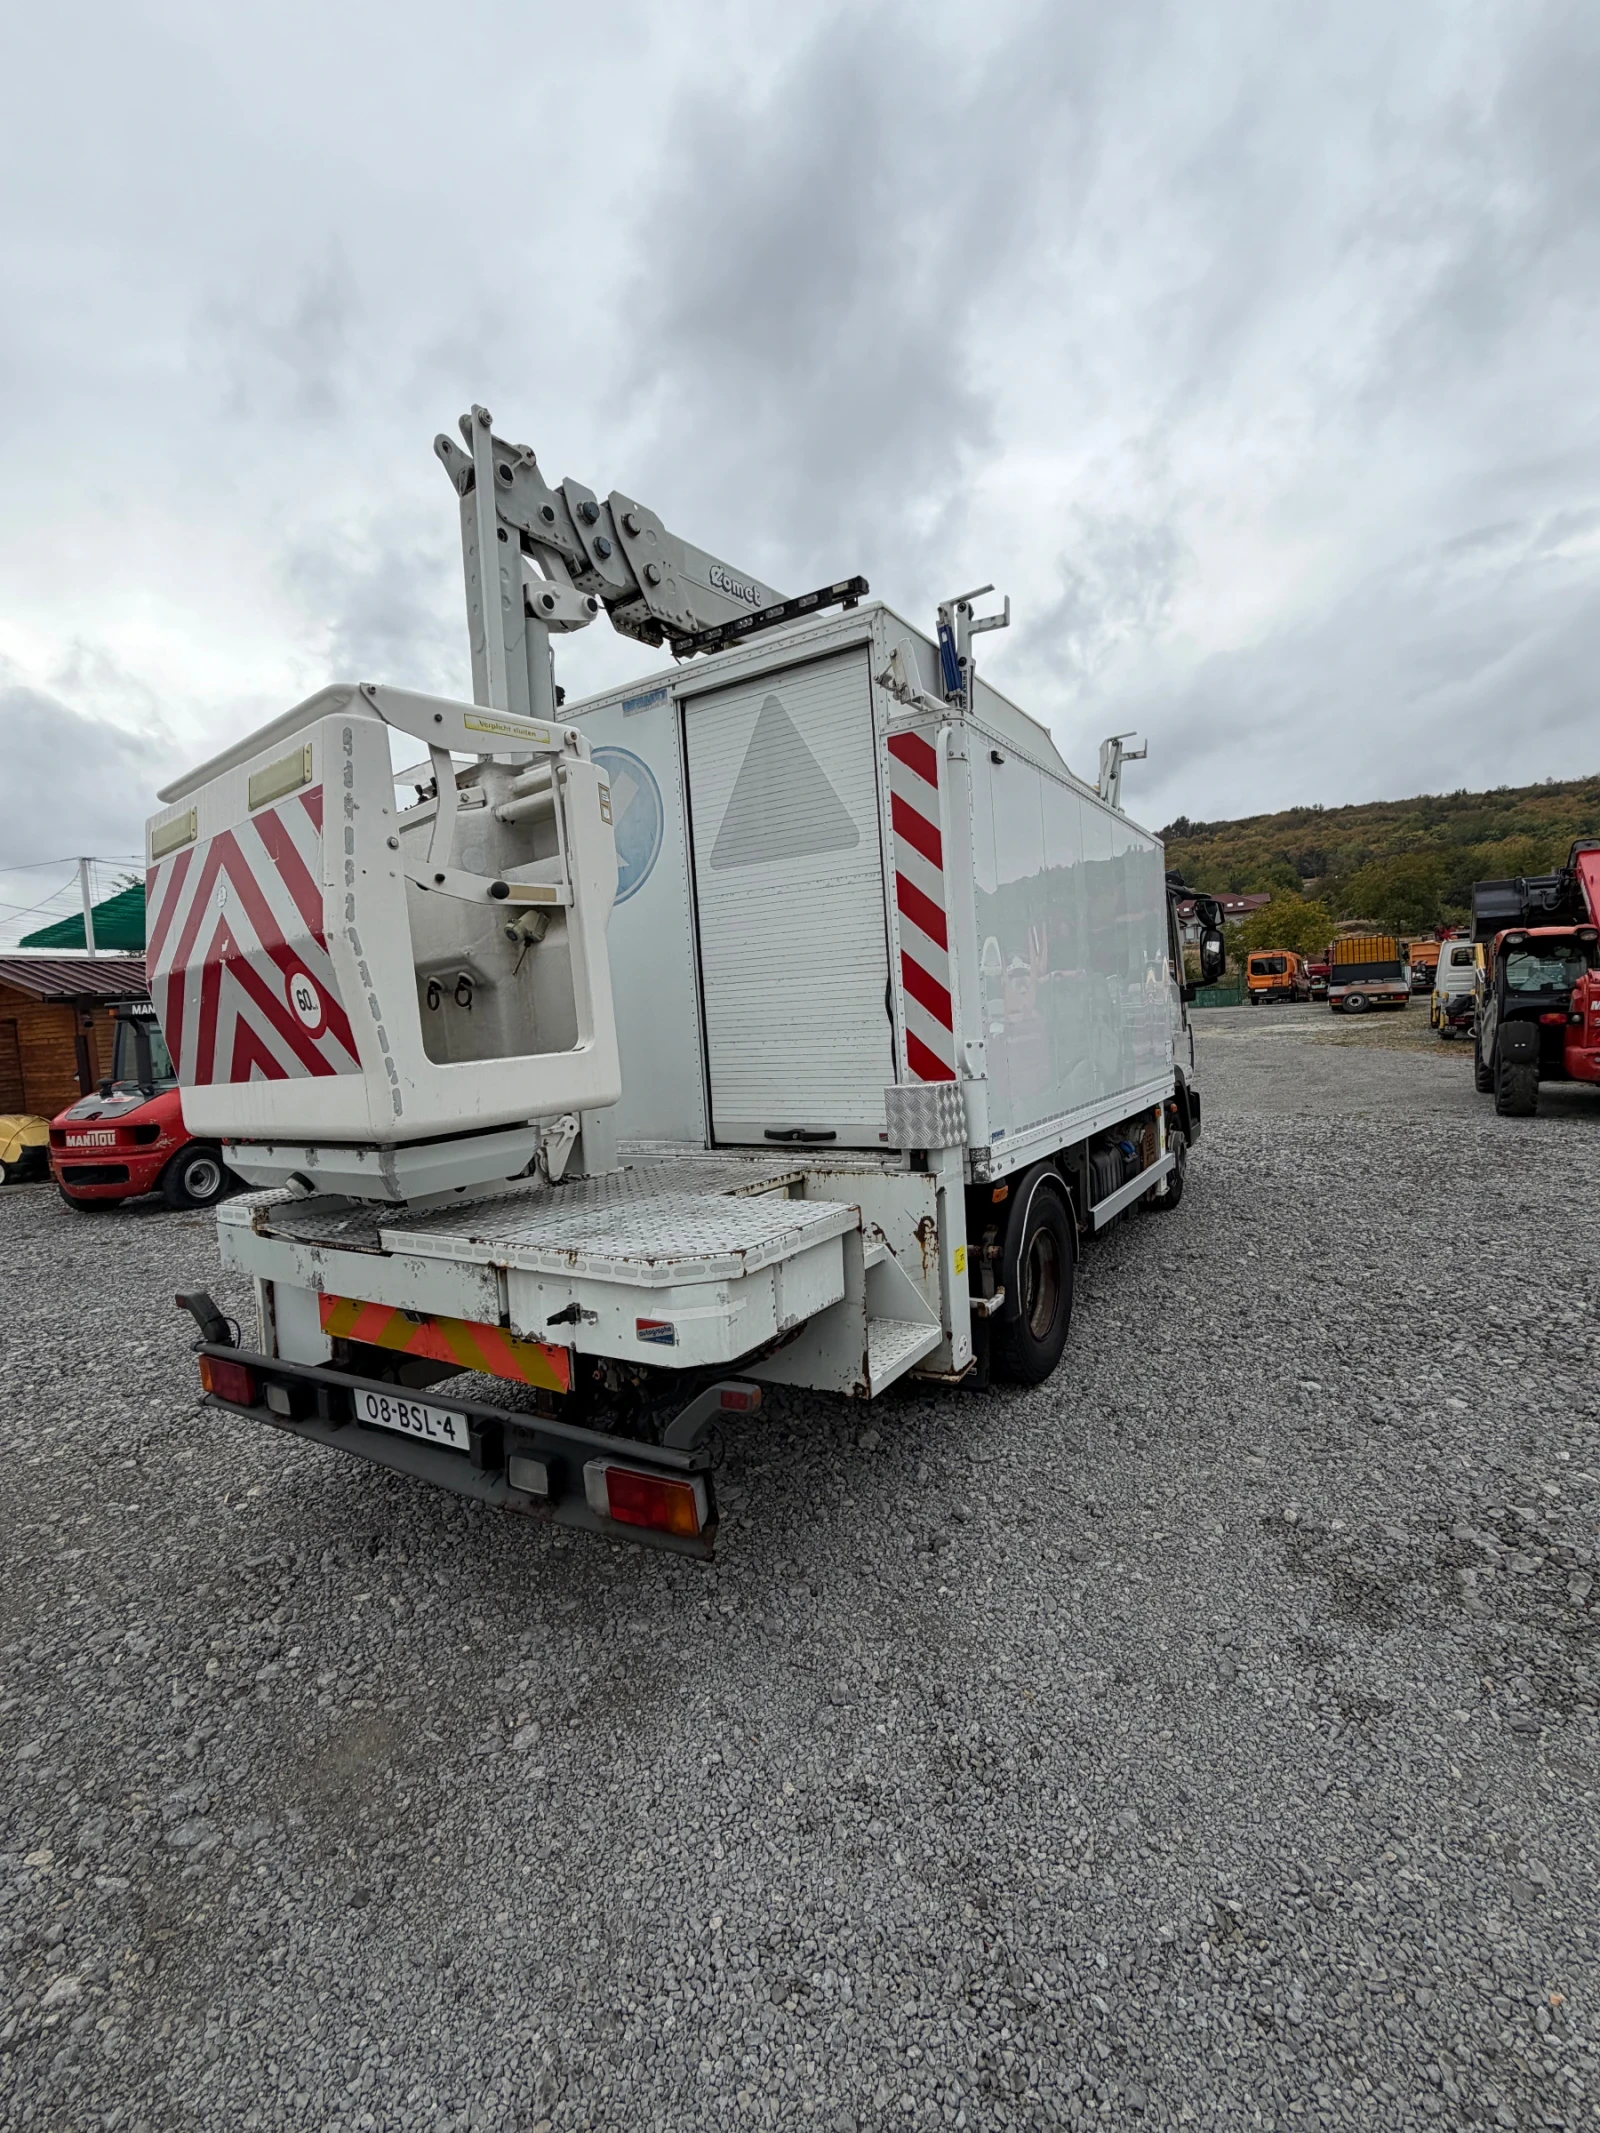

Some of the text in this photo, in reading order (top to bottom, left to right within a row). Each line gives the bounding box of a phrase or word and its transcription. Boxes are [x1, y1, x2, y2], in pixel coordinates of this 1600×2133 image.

[709, 565, 761, 607] Comet
[479, 719, 512, 732] Verplicht
[296, 988, 312, 1011] 60
[66, 1130, 116, 1147] MANITOU
[366, 1394, 456, 1441] 08-BSL-4
